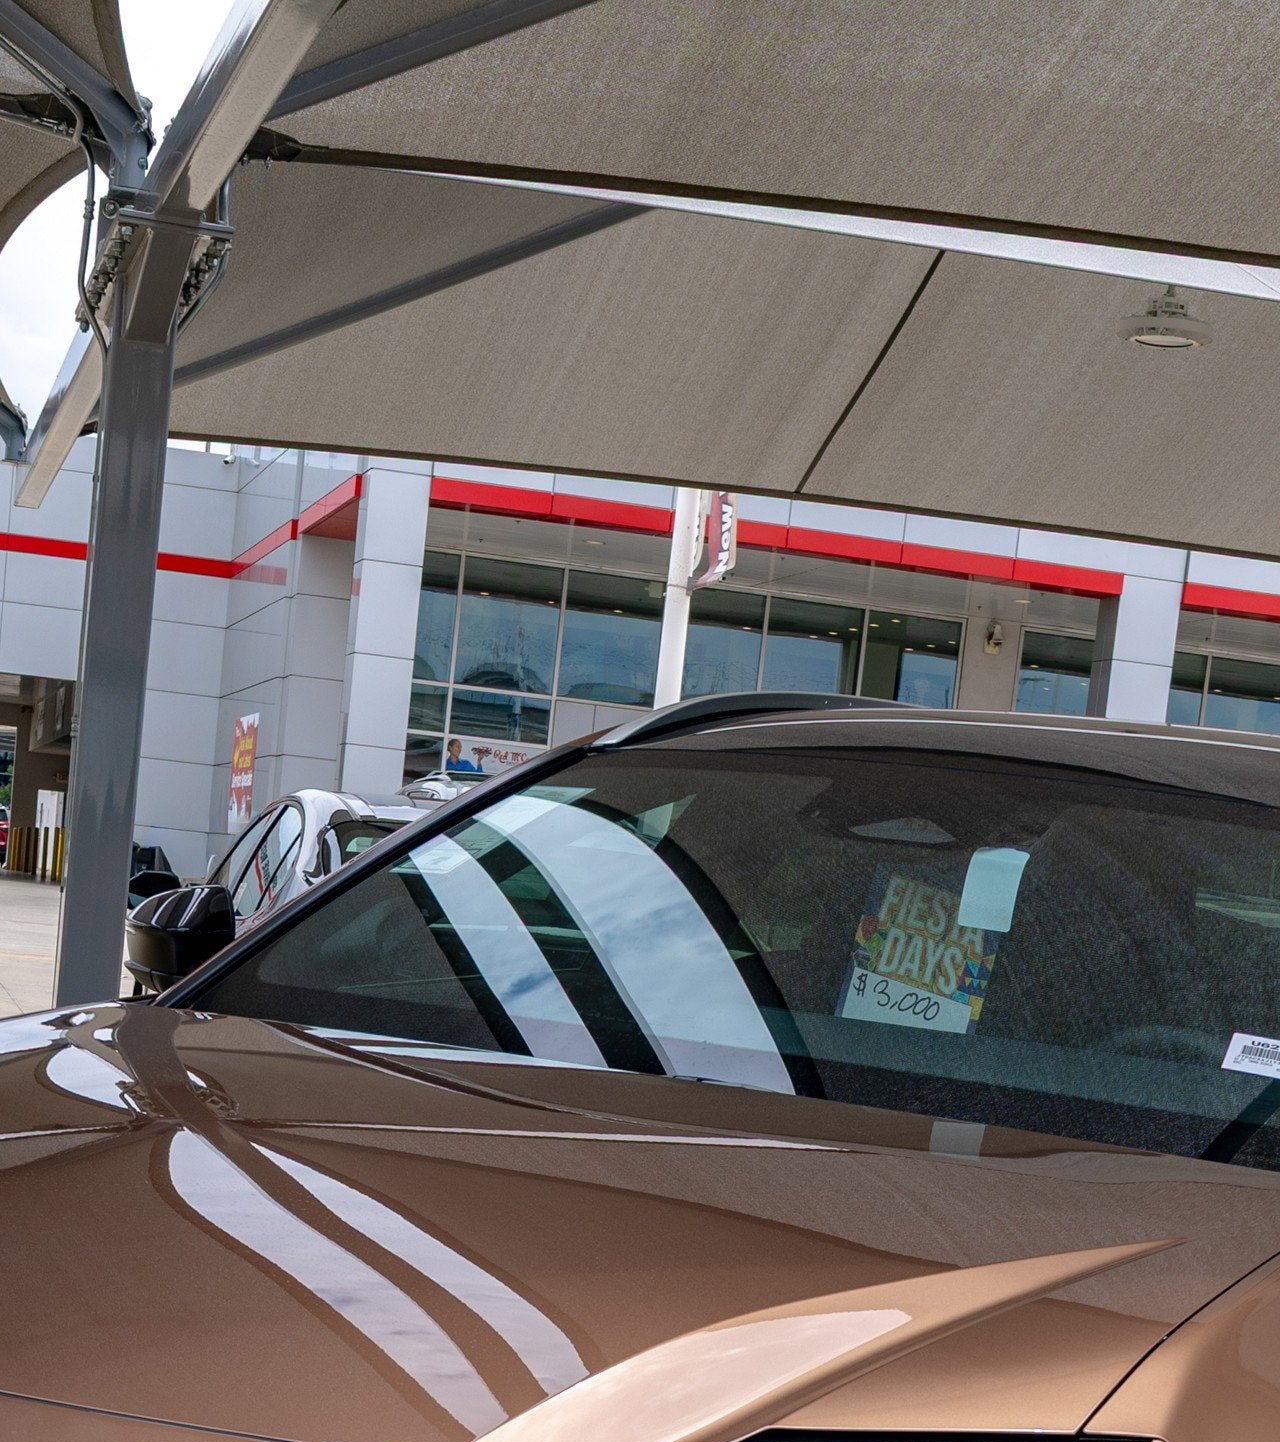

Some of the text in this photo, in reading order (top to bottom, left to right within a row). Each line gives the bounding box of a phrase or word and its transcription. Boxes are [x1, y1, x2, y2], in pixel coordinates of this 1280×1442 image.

[714, 504, 733, 573] New
[876, 926, 964, 996] DAYS
[852, 972, 940, 1021] $ 3,000
